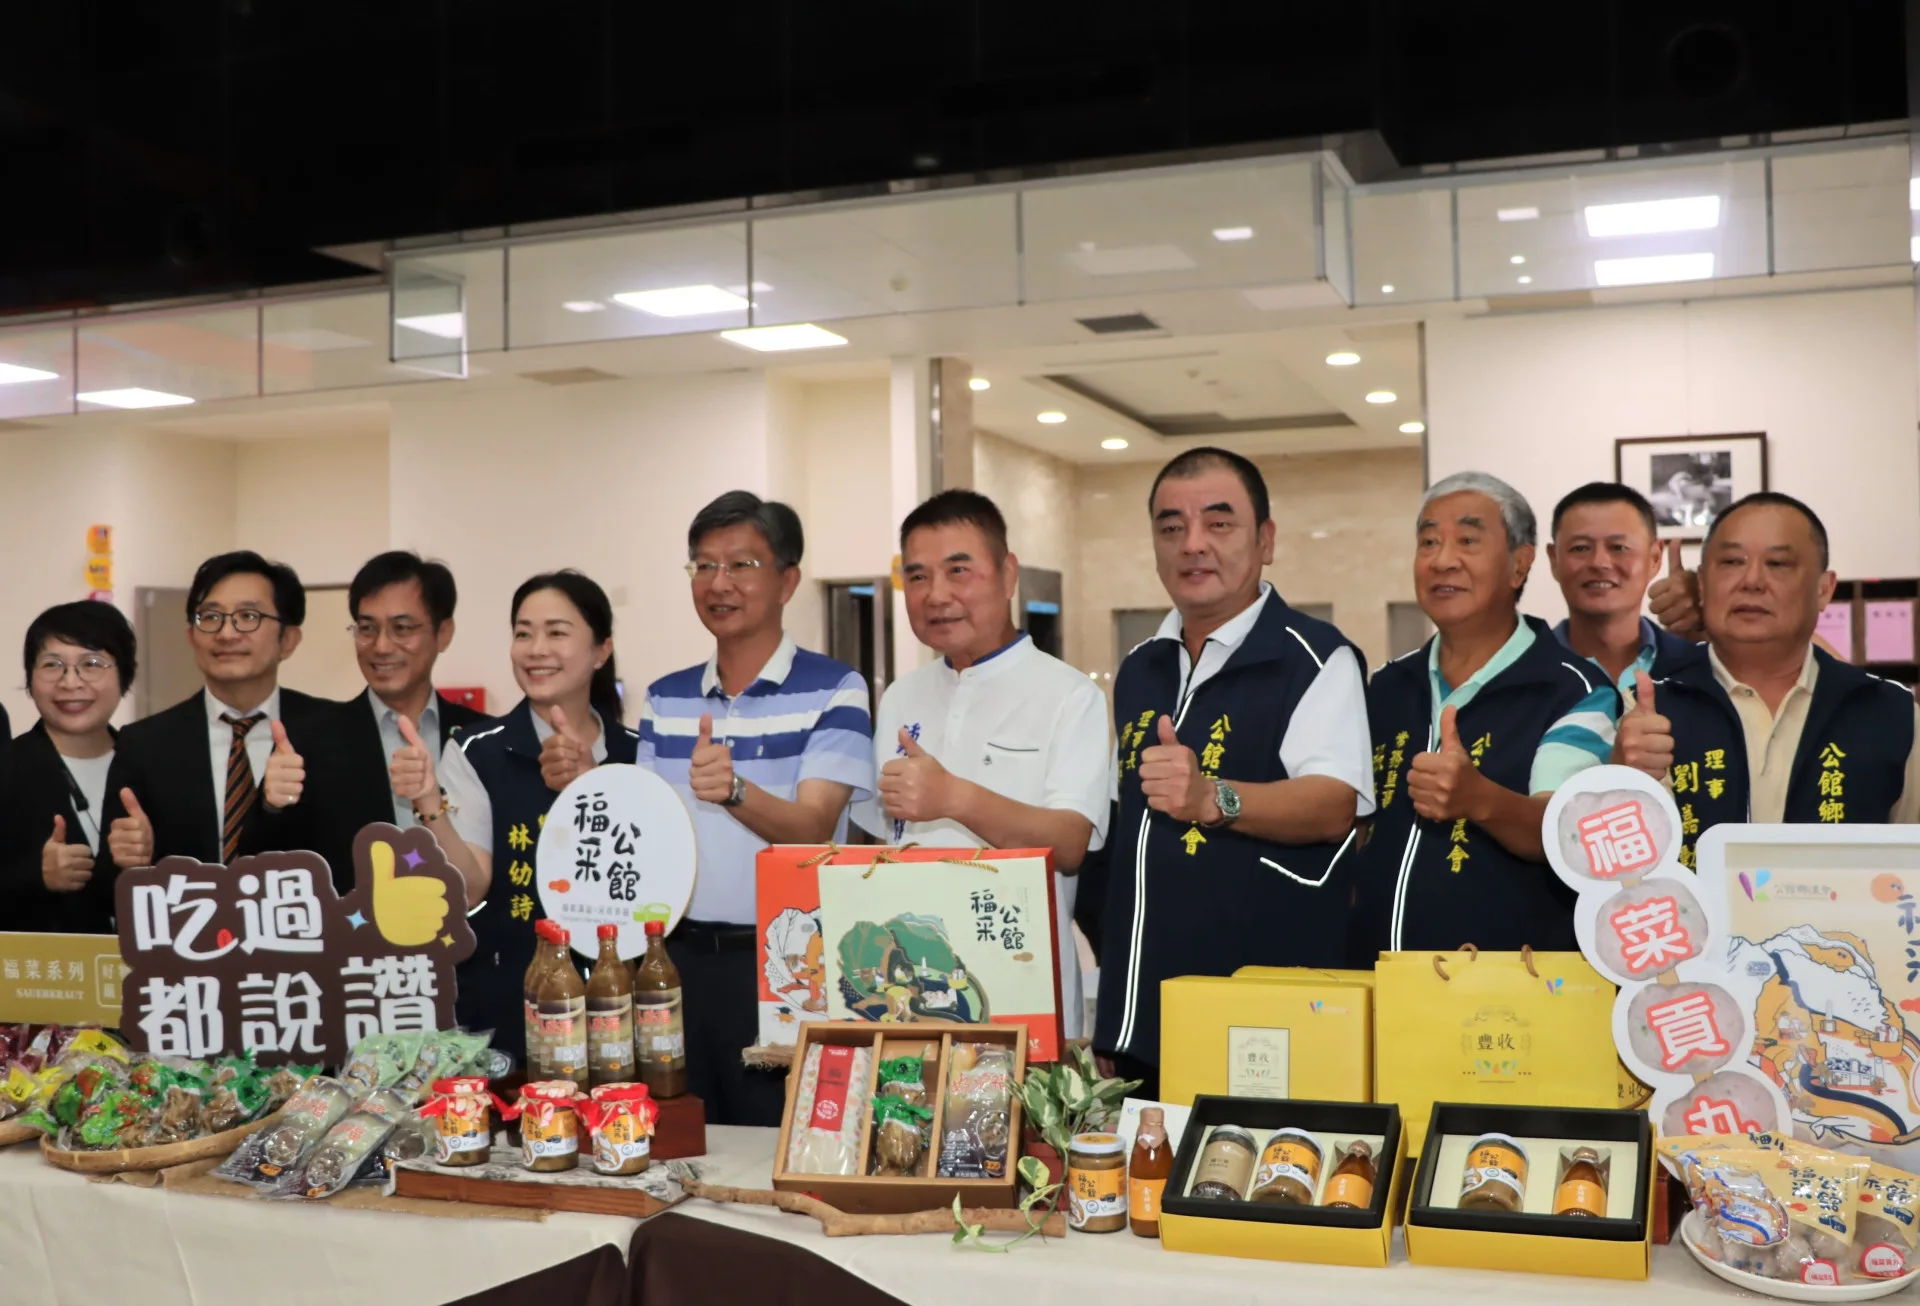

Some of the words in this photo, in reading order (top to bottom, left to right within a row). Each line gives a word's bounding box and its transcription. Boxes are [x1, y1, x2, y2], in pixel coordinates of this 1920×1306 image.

[1704, 748, 1726, 799] 理事
[508, 823, 535, 922] 林幼詩
[606, 822, 642, 902] 公館
[131, 868, 325, 961] 吃過
[999, 904, 1025, 950] 公館
[3, 958, 86, 982] 福菜系列
[137, 953, 439, 1060] 都說讚
[1477, 1032, 1516, 1051] 豐收
